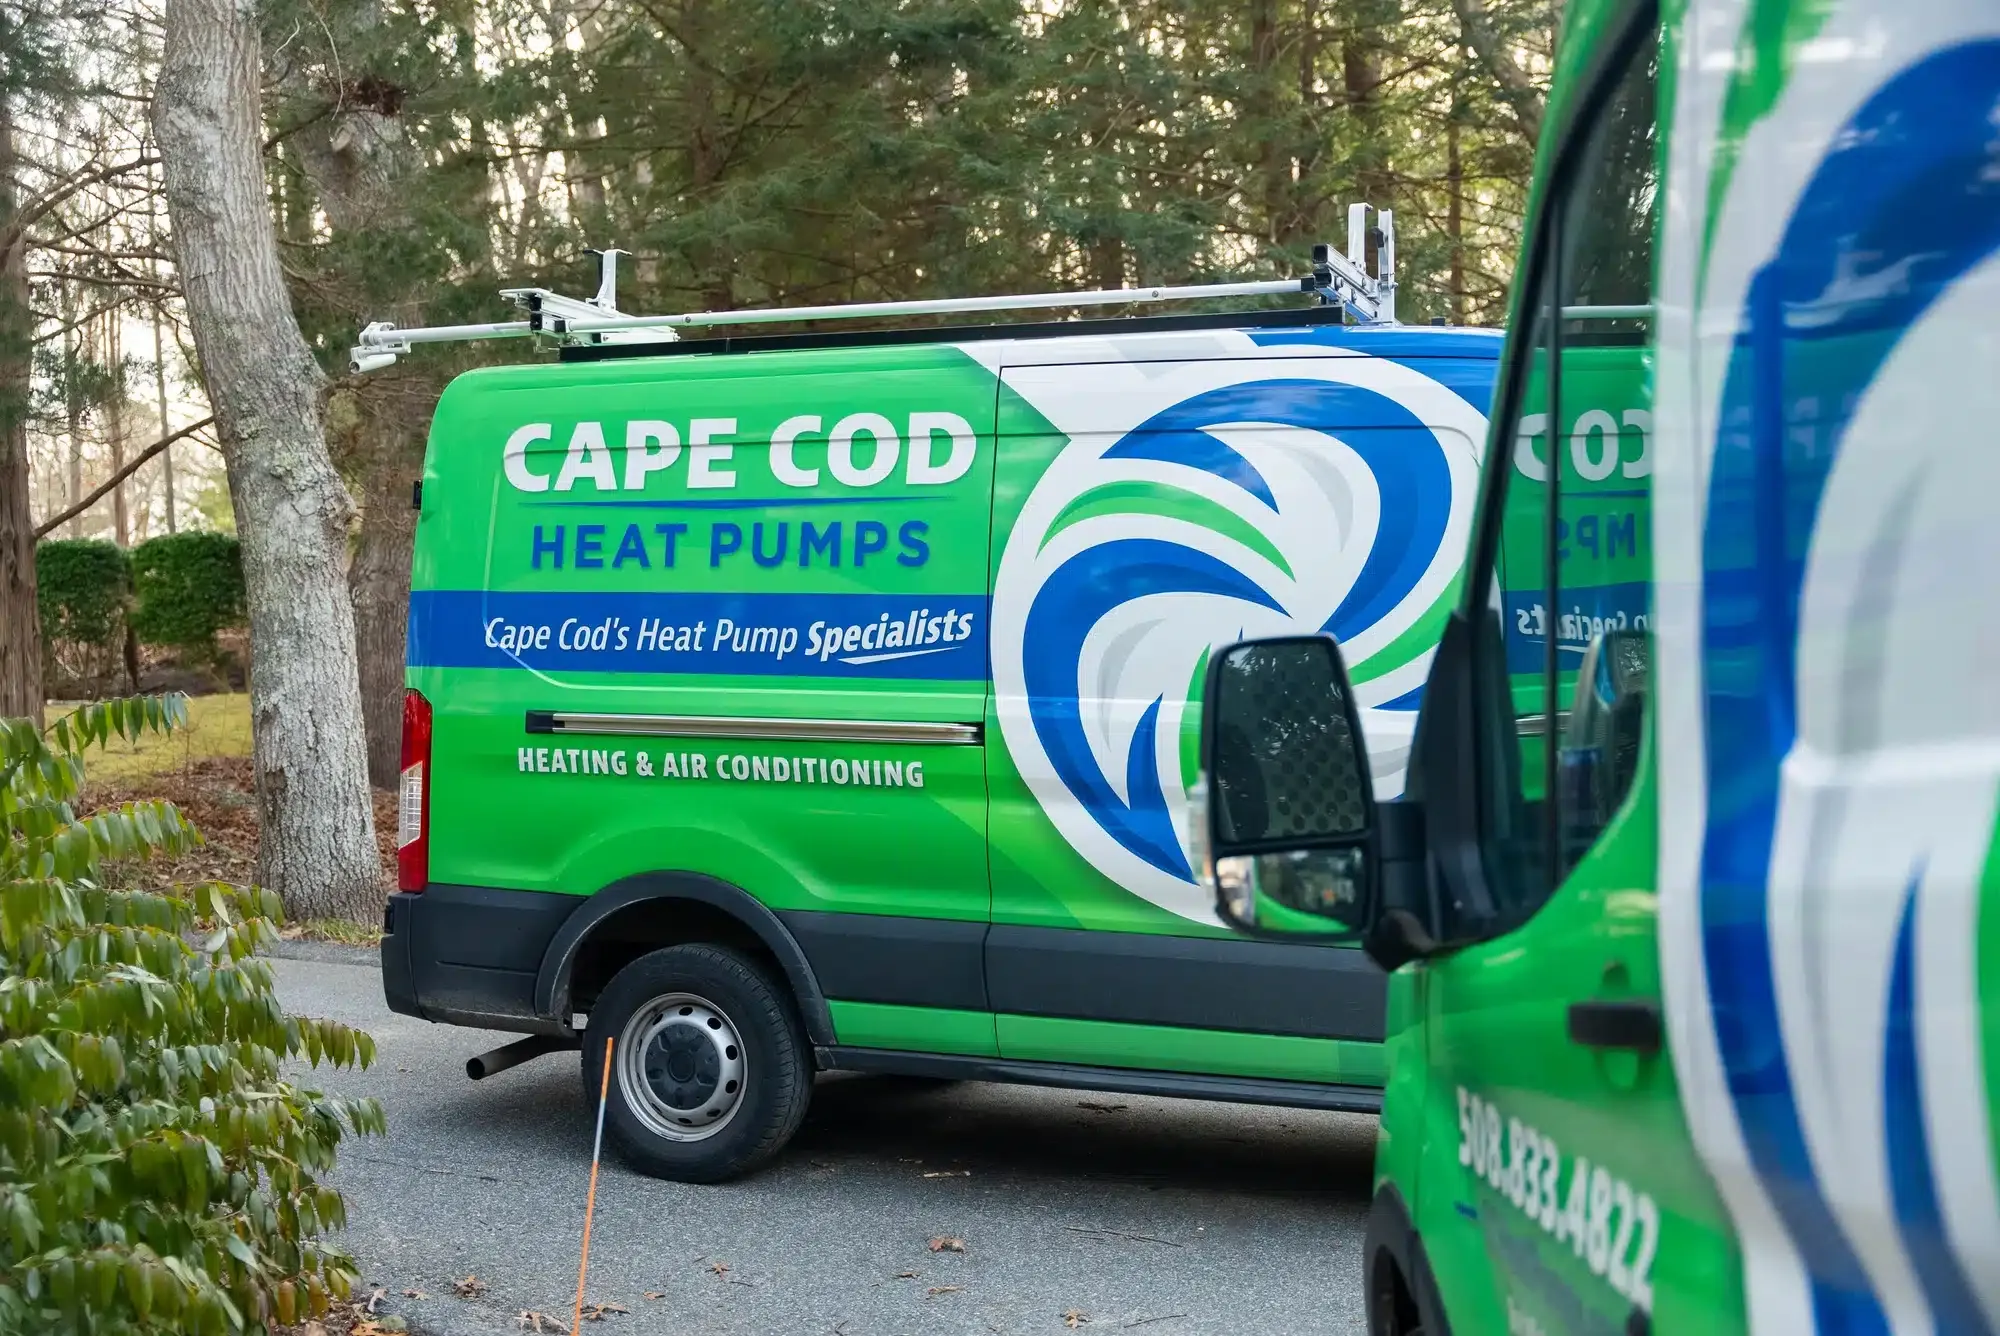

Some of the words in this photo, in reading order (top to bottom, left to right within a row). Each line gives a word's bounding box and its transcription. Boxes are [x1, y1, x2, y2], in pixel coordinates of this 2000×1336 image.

[503, 418, 738, 492] CAPE
[769, 411, 977, 488] COD
[531, 524, 687, 569] HEAT
[709, 520, 930, 568] PUMPS
[484, 617, 551, 656] Cape
[558, 617, 628, 651] Cod's
[637, 619, 706, 651] Heat
[713, 620, 798, 660] Pump
[805, 608, 973, 662] Specialists
[517, 747, 628, 776] HEATING
[635, 753, 655, 778] &
[663, 754, 708, 780] AIR
[716, 756, 925, 788] CONDITIONING
[1457, 1086, 1658, 1312] 508.833.4822
